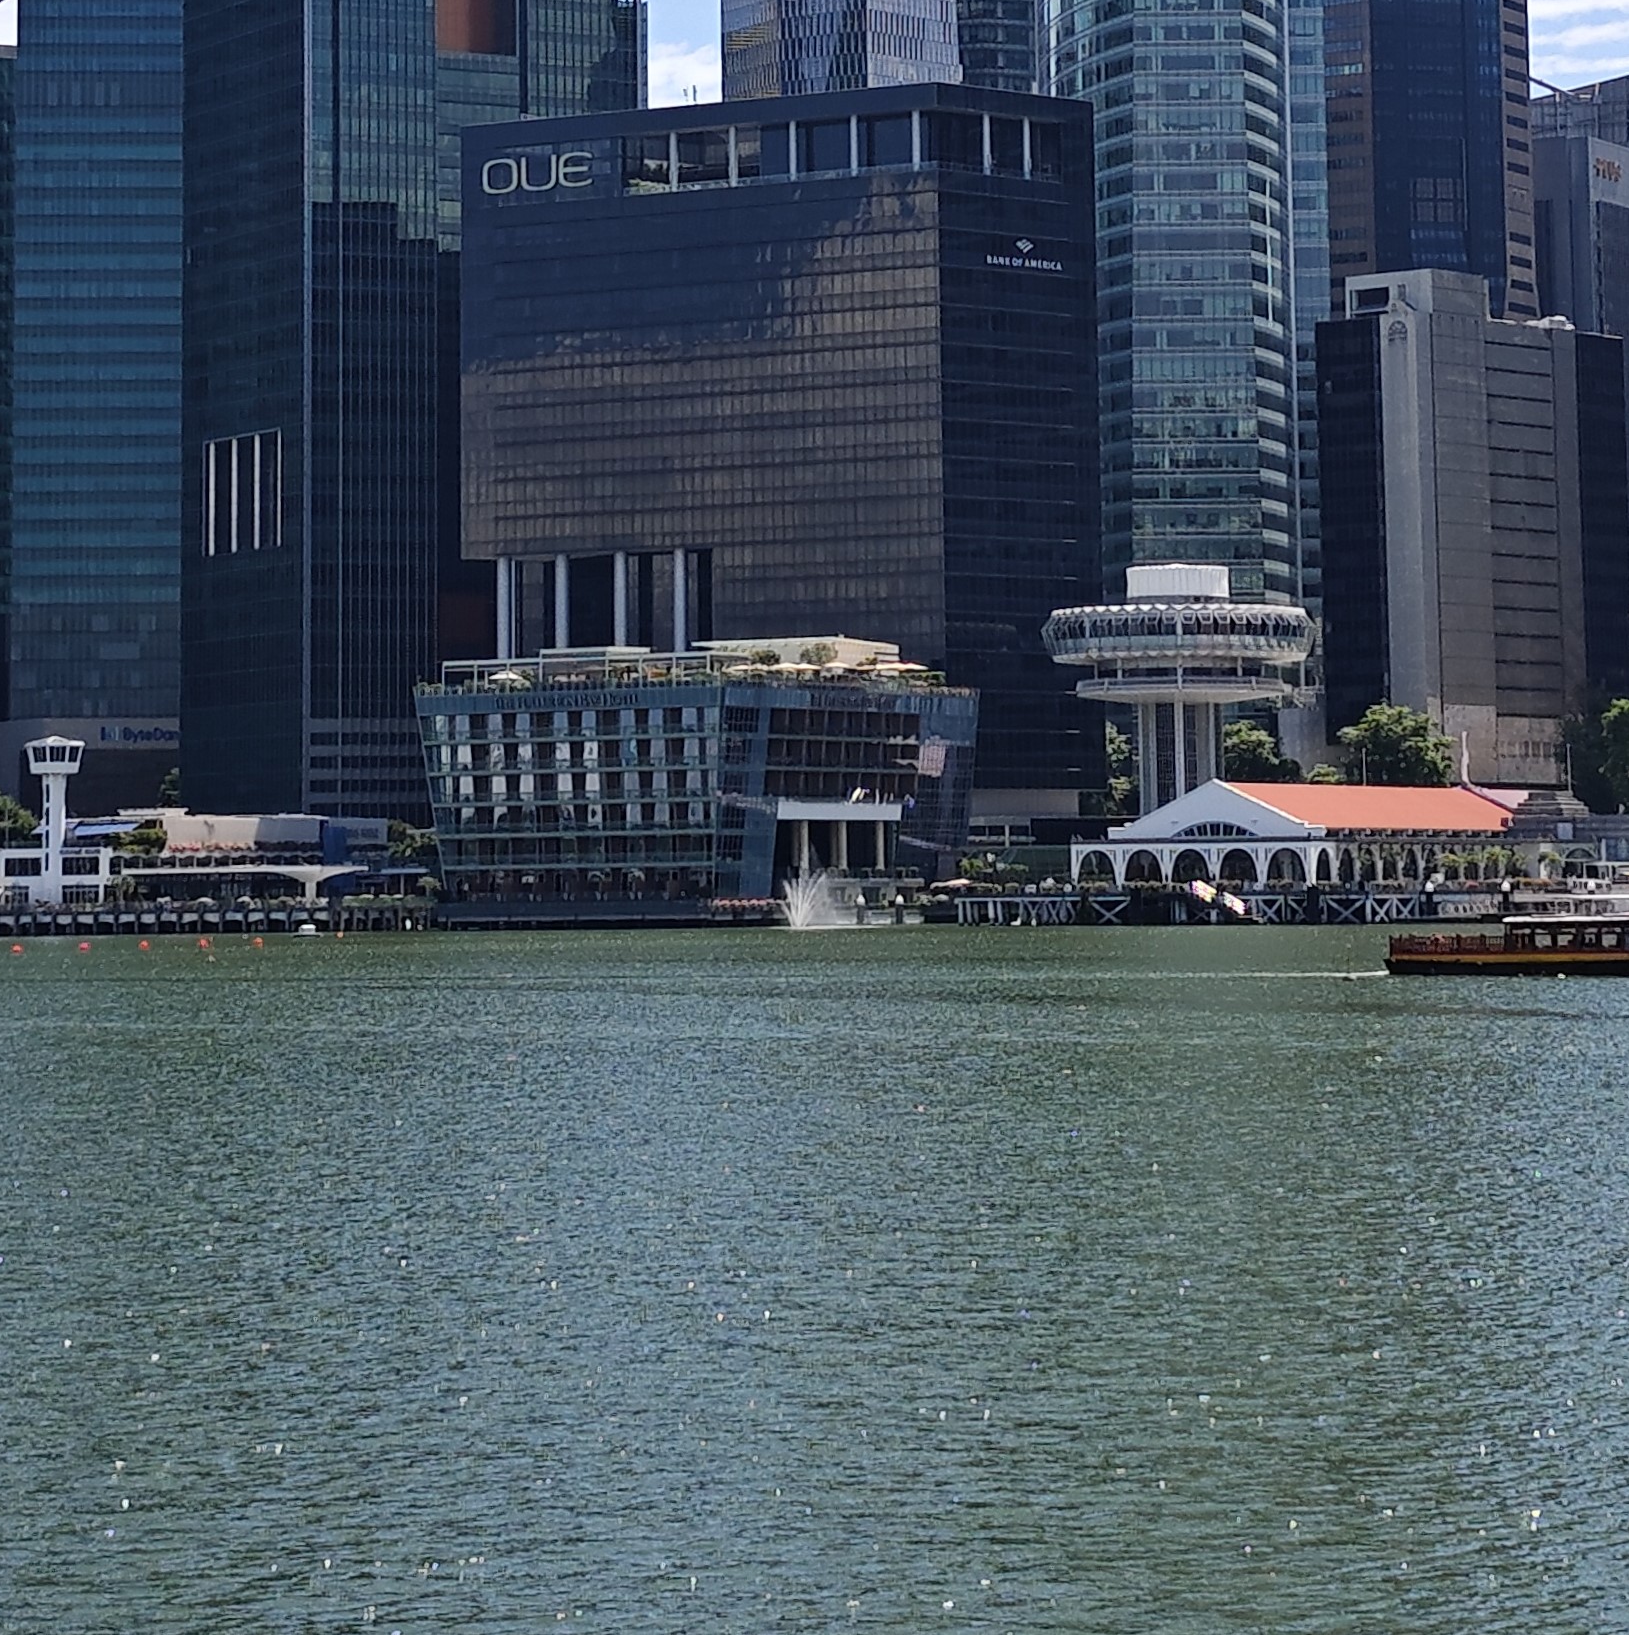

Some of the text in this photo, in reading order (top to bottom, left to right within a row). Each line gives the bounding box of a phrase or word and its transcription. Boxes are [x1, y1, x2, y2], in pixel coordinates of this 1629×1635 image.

[482, 152, 593, 194] OUE
[986, 254, 1063, 271] BANK OF AMERICA
